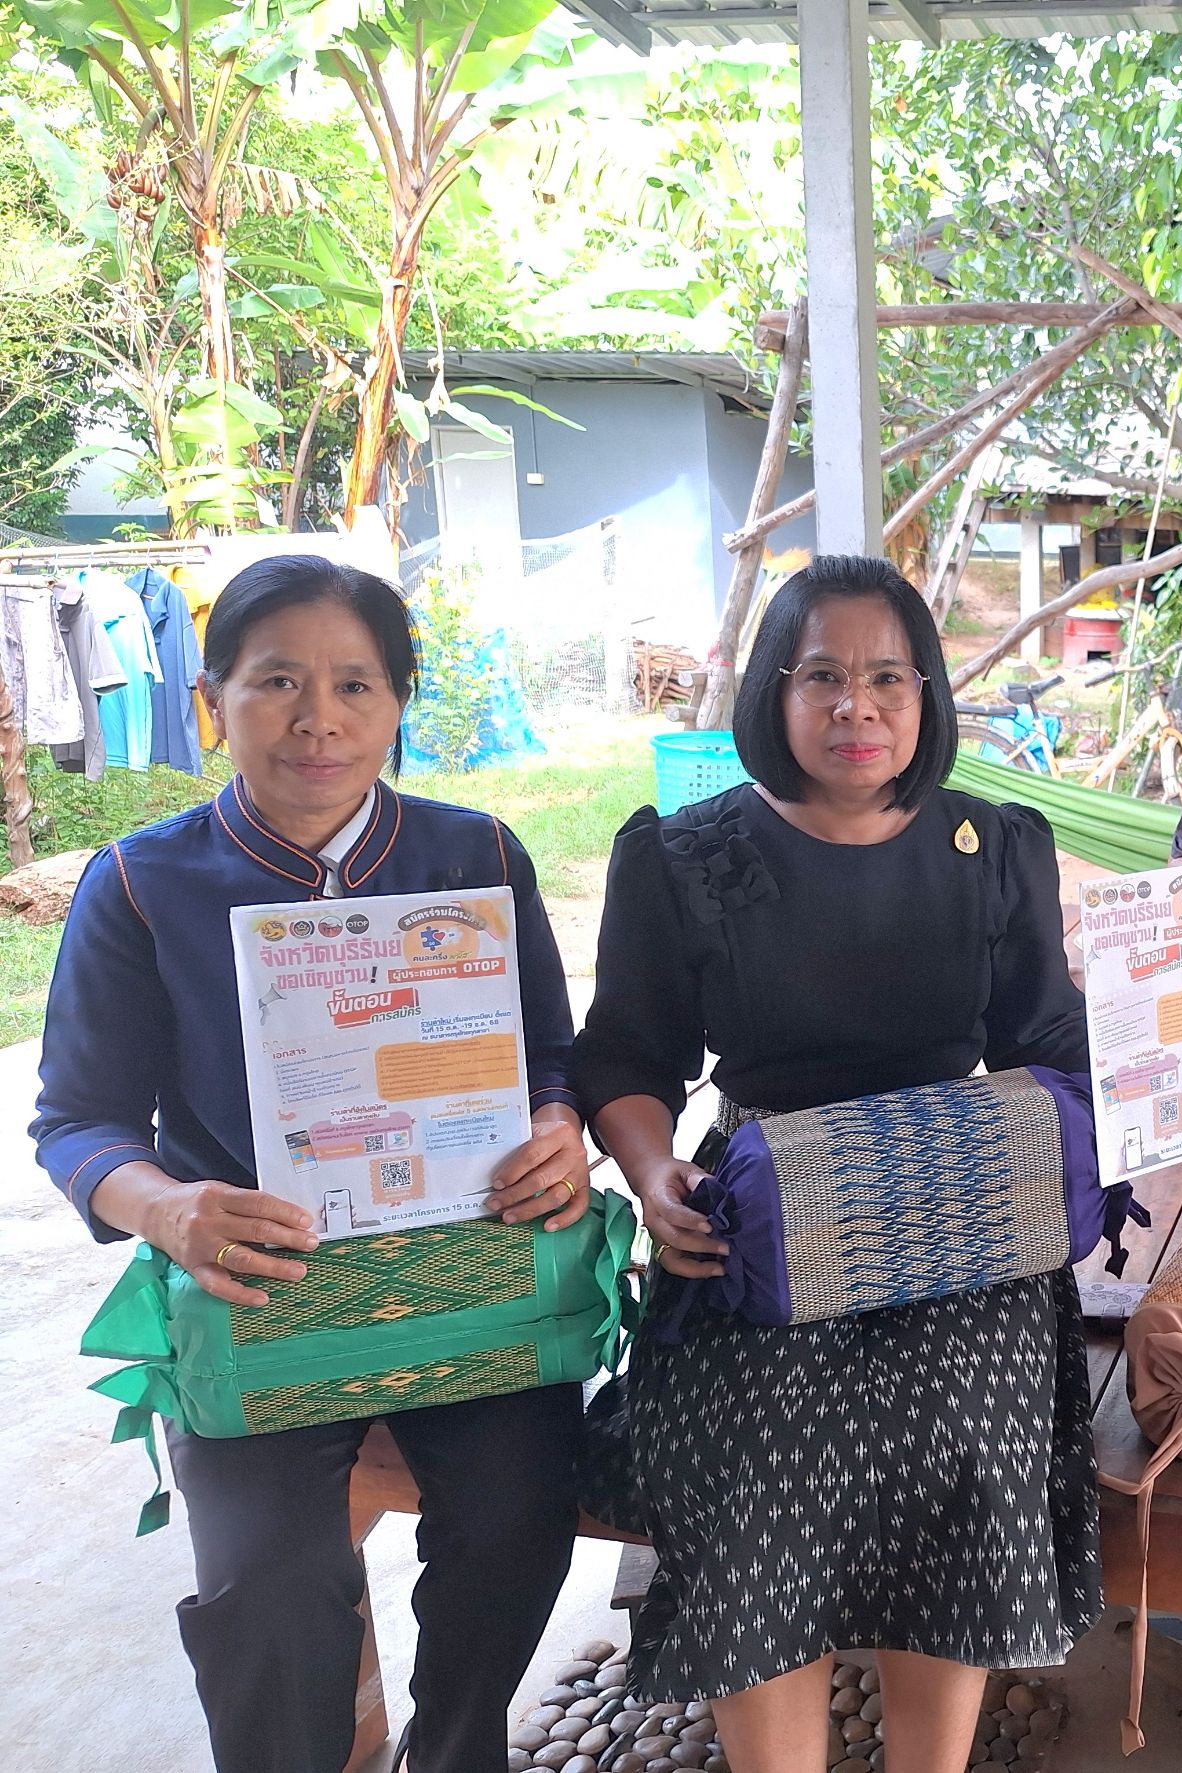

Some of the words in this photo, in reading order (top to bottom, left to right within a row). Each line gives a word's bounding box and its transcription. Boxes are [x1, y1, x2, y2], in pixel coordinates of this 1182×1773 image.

[346, 920, 369, 928] OTOP
[1126, 947, 1167, 971] ขั้นตอน
[392, 966, 457, 981] ผู้ประกอบการ
[463, 960, 500, 973] OTOP
[328, 989, 392, 1015] ขั้นตอน
[371, 1005, 422, 1024] การสมัคร
[383, 1208, 450, 1221] ระยะเวลาโครงการ
[452, 1203, 462, 1211] 15
